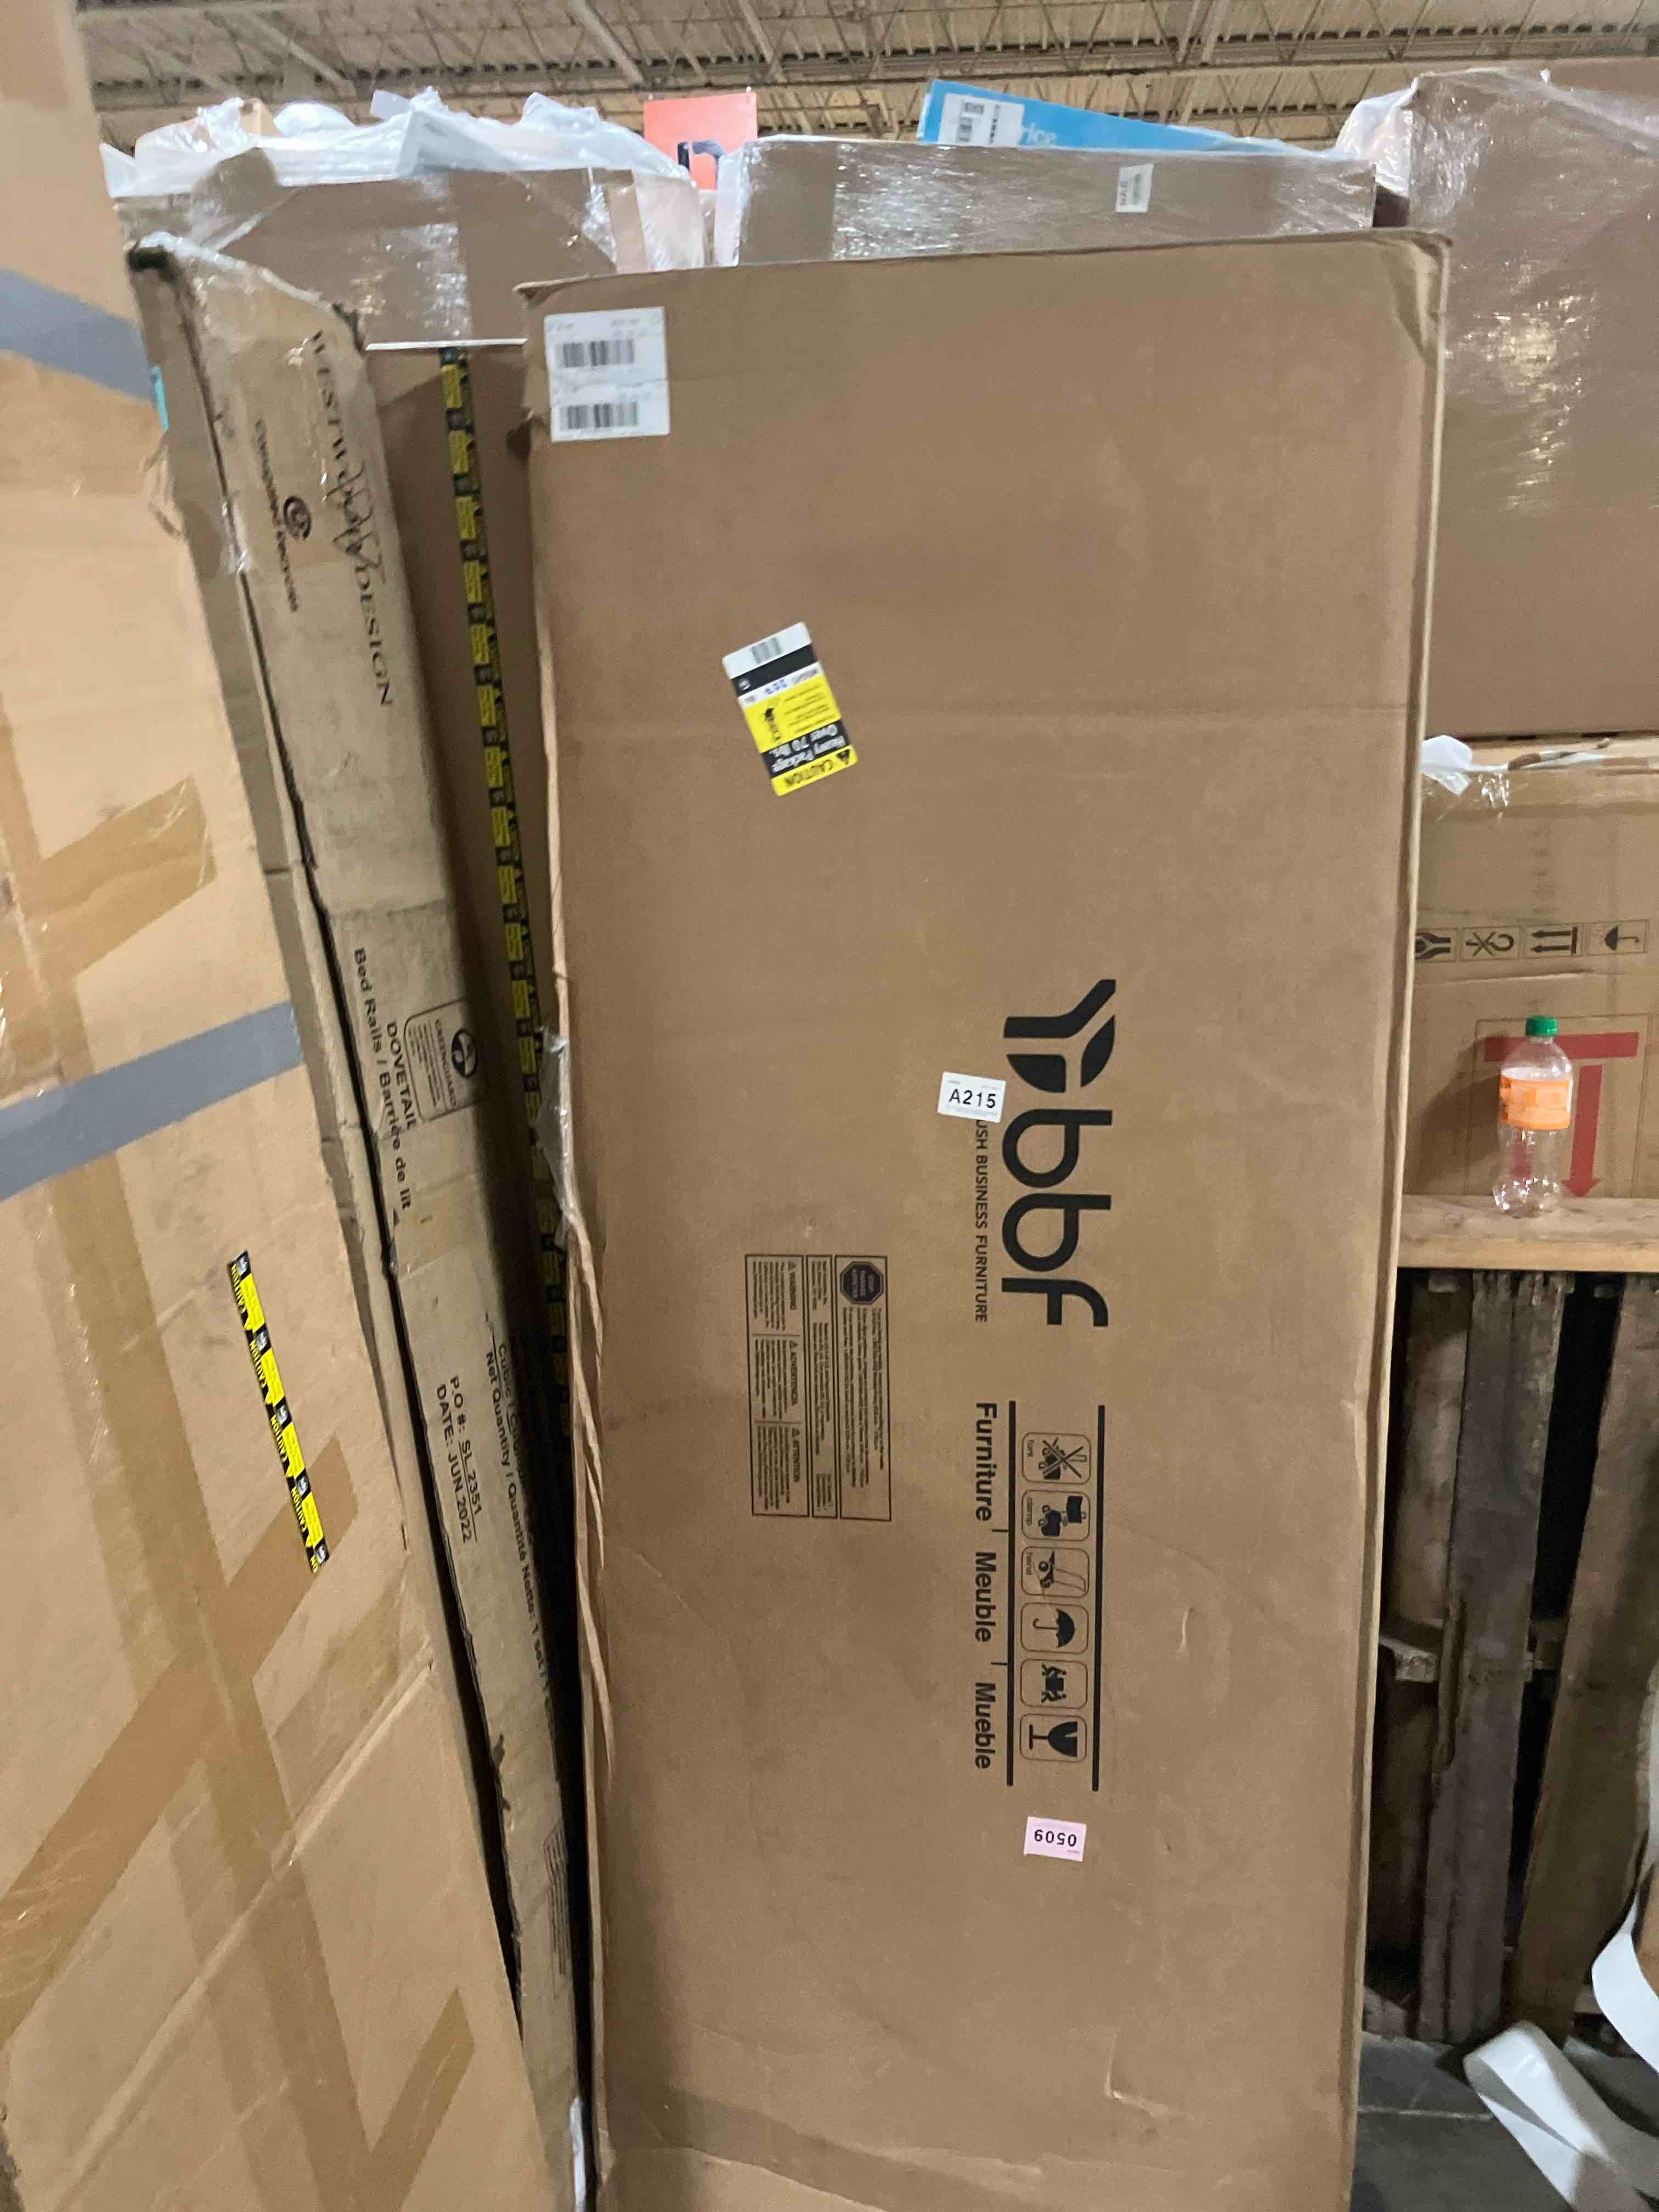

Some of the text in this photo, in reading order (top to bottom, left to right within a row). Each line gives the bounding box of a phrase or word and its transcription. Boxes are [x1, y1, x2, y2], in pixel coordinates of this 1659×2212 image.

[354, 566, 393, 706] DESIGN
[783, 759, 834, 787] CAUTION
[353, 947, 371, 992] Bed
[364, 998, 383, 1053] Rails
[386, 1020, 416, 1130] DOVETAIL
[949, 1088, 997, 1108] A215
[394, 1156, 408, 1183] de
[399, 1188, 411, 1210] lit
[1002, 1109, 1112, 1327] bbf
[975, 1119, 988, 1323] USH BUSINESS FURNITURE
[485, 1351, 498, 1383] Net
[436, 1384, 453, 1447] DATE:
[490, 1388, 511, 1468] Quantity
[1026, 1440, 1036, 1458] fork
[1025, 1497, 1034, 1525] clamp
[1025, 1552, 1034, 1575] hand
[974, 1403, 997, 1769] Furniture Meuble Mueble
[1034, 1829, 1077, 1847] 0509
